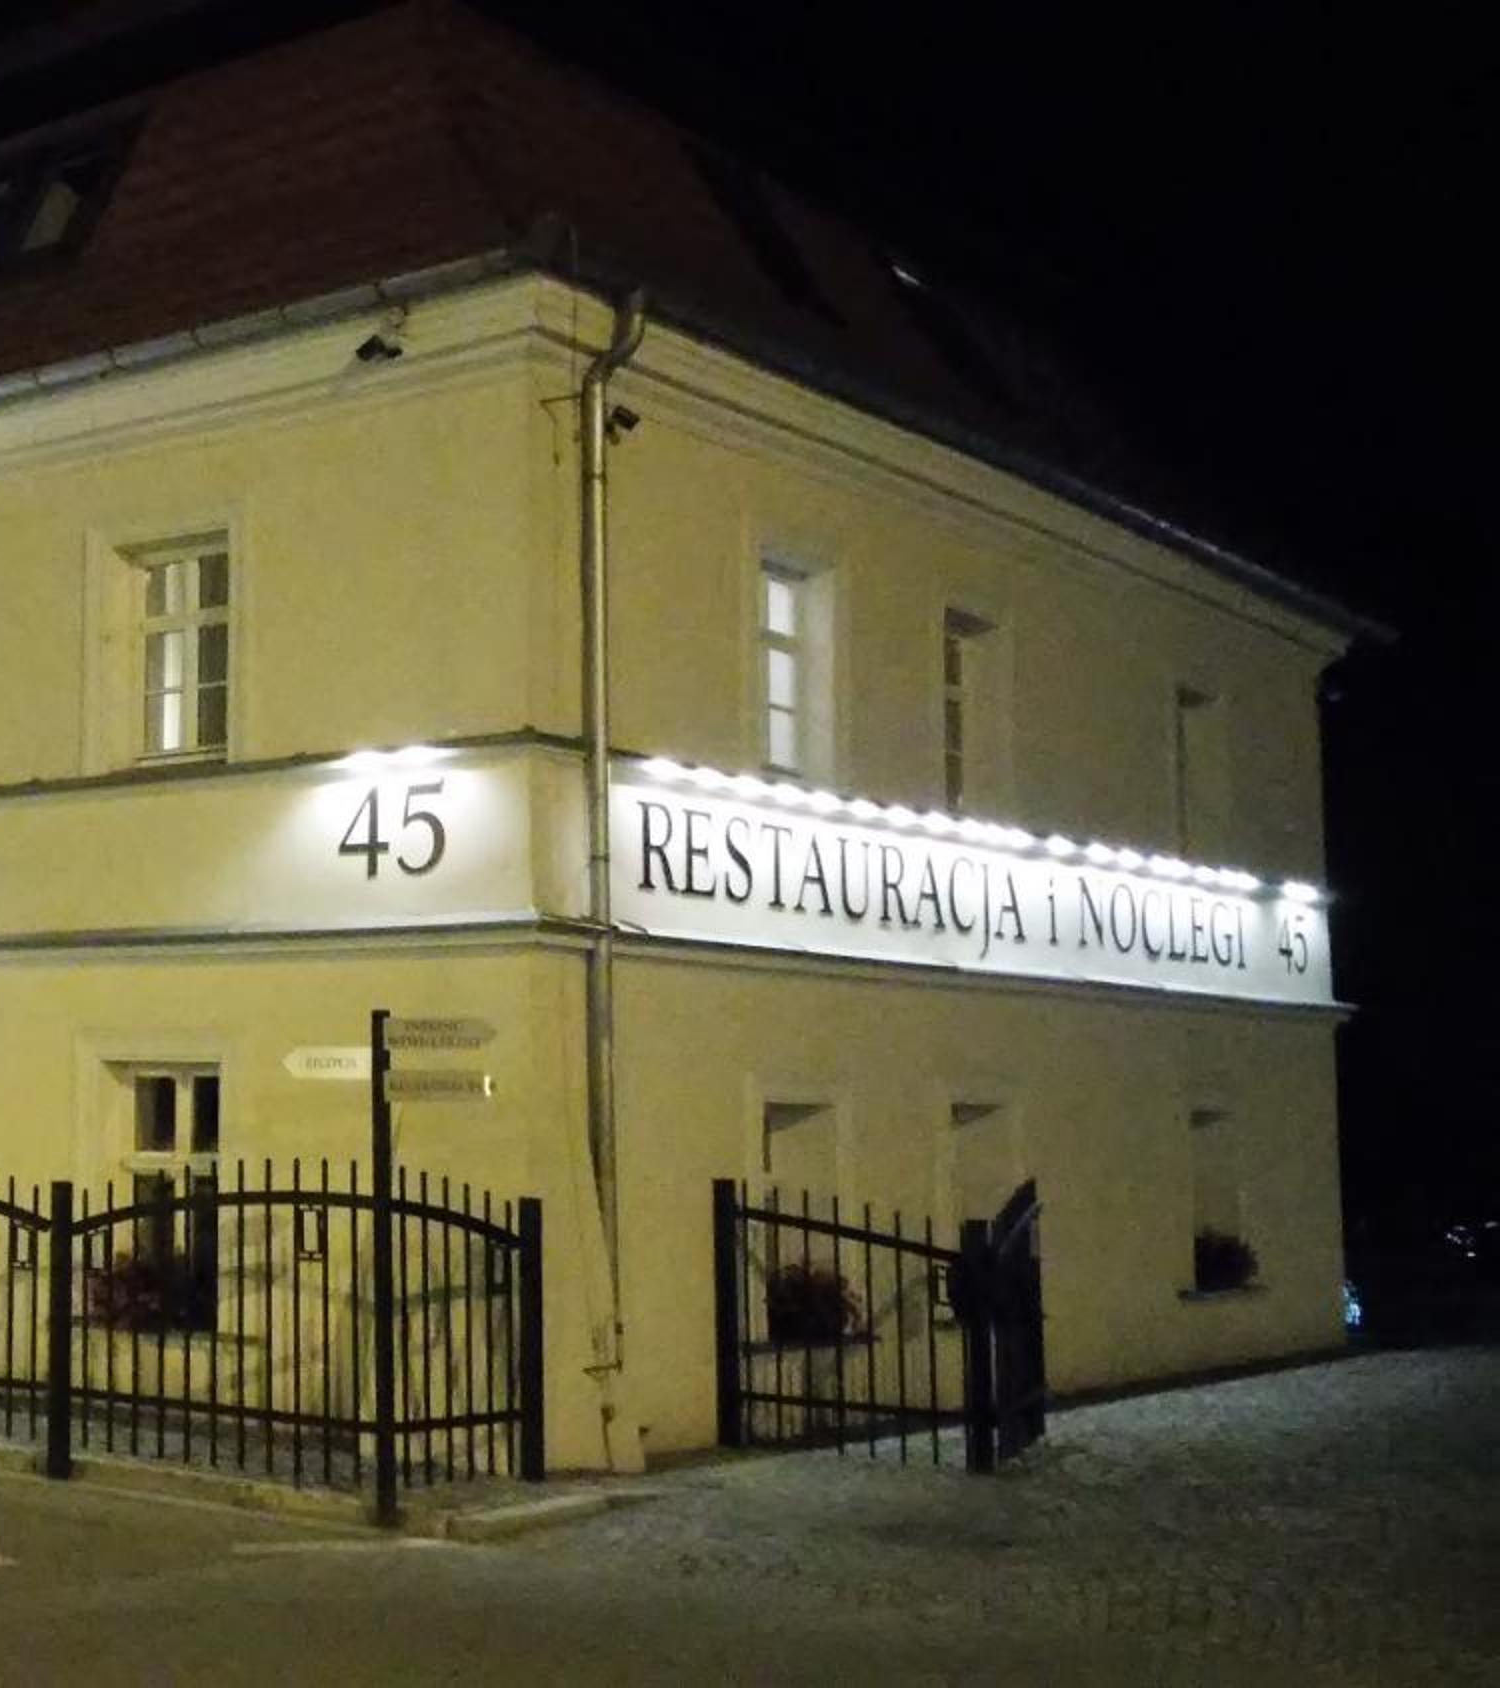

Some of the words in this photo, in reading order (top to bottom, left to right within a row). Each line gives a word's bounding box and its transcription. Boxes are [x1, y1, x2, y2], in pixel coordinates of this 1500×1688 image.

[338, 777, 445, 880] 45
[637, 800, 1027, 961] RESTAURACJA
[1078, 876, 1246, 970] NOCLEGI
[1278, 912, 1308, 976] 45
